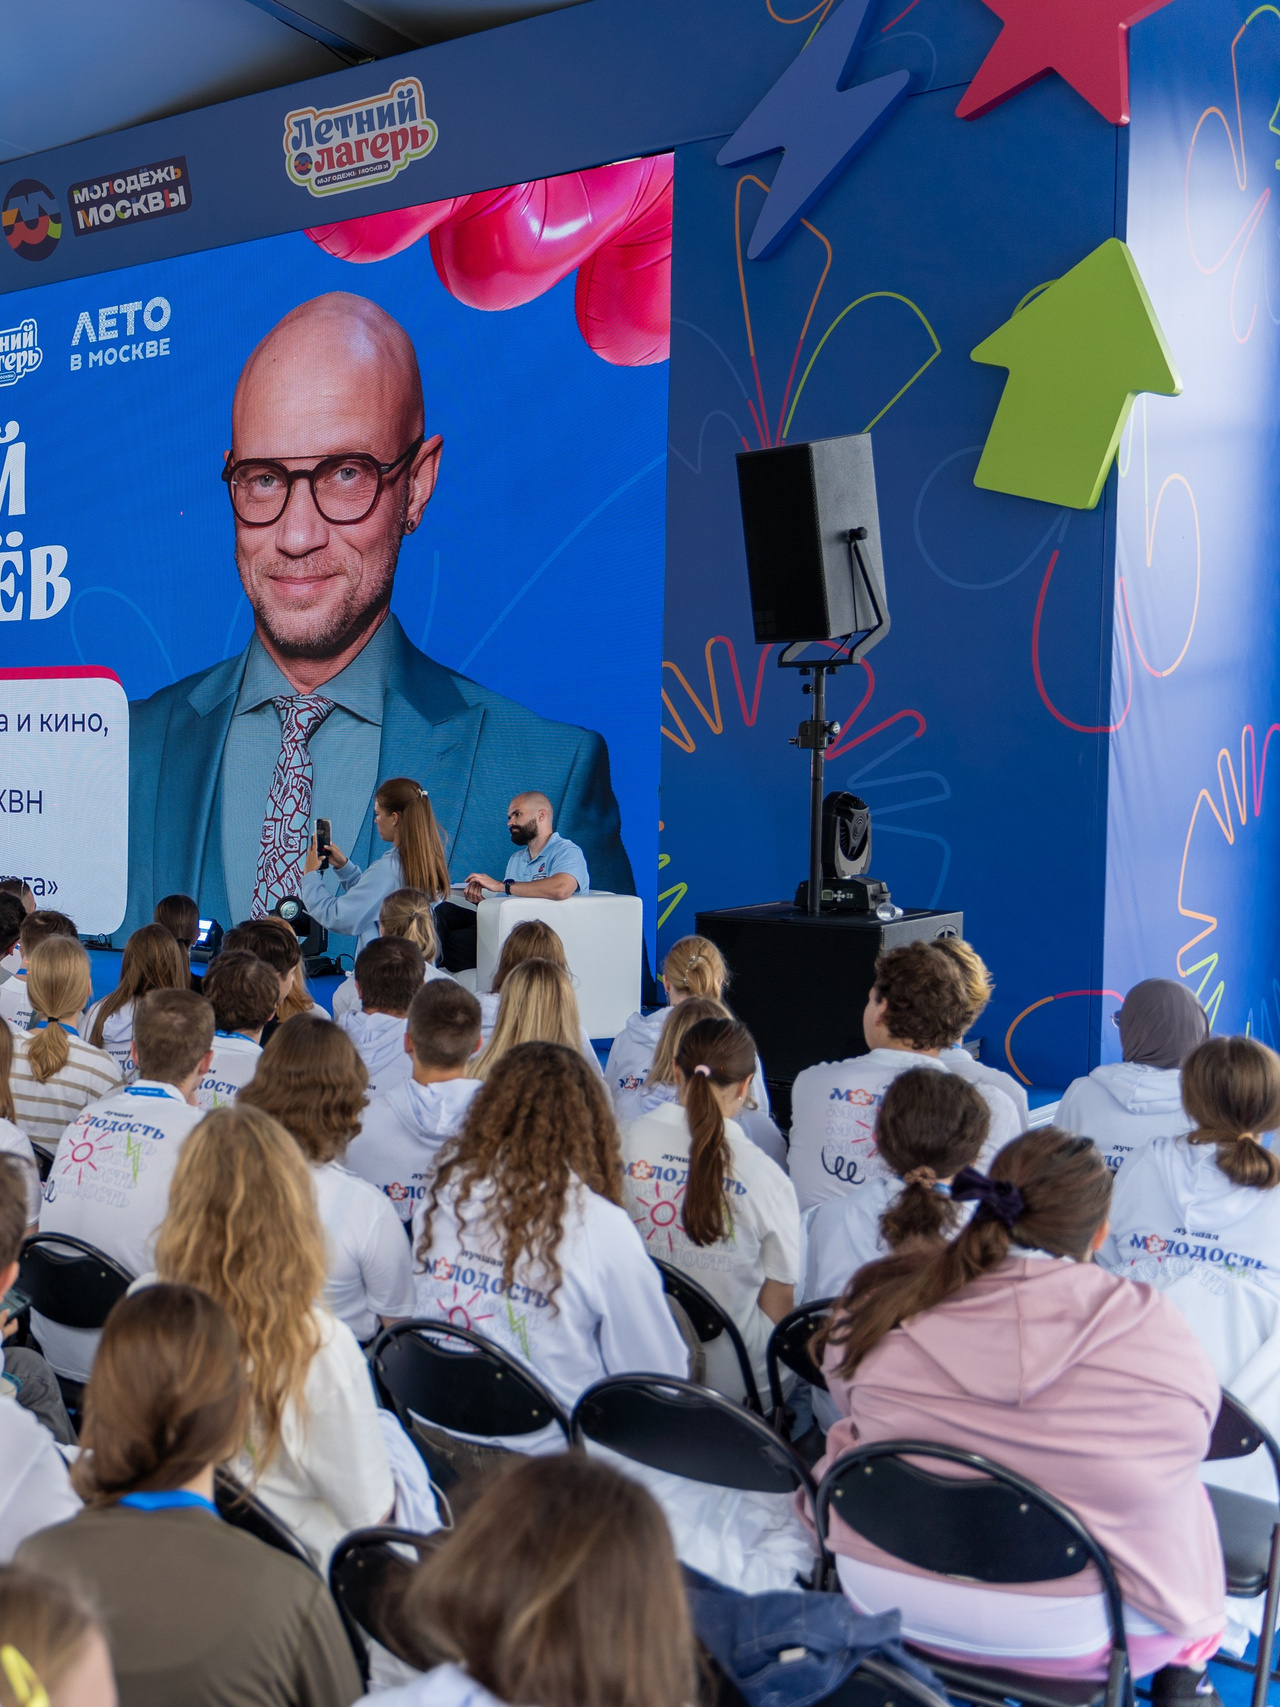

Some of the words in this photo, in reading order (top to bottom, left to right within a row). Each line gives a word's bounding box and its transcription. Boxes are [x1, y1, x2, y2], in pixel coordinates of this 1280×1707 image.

[291, 88, 418, 151] Летний
[314, 125, 429, 173] лагерь
[73, 166, 182, 205] МОЛОДЁЖЬ
[77, 185, 187, 229] МОСКВЫ
[71, 296, 171, 347] ЛЕТО
[70, 353, 82, 371] В
[88, 337, 171, 368] МОСКВЕ
[17, 714, 32, 732] и
[39, 712, 109, 736] кино,
